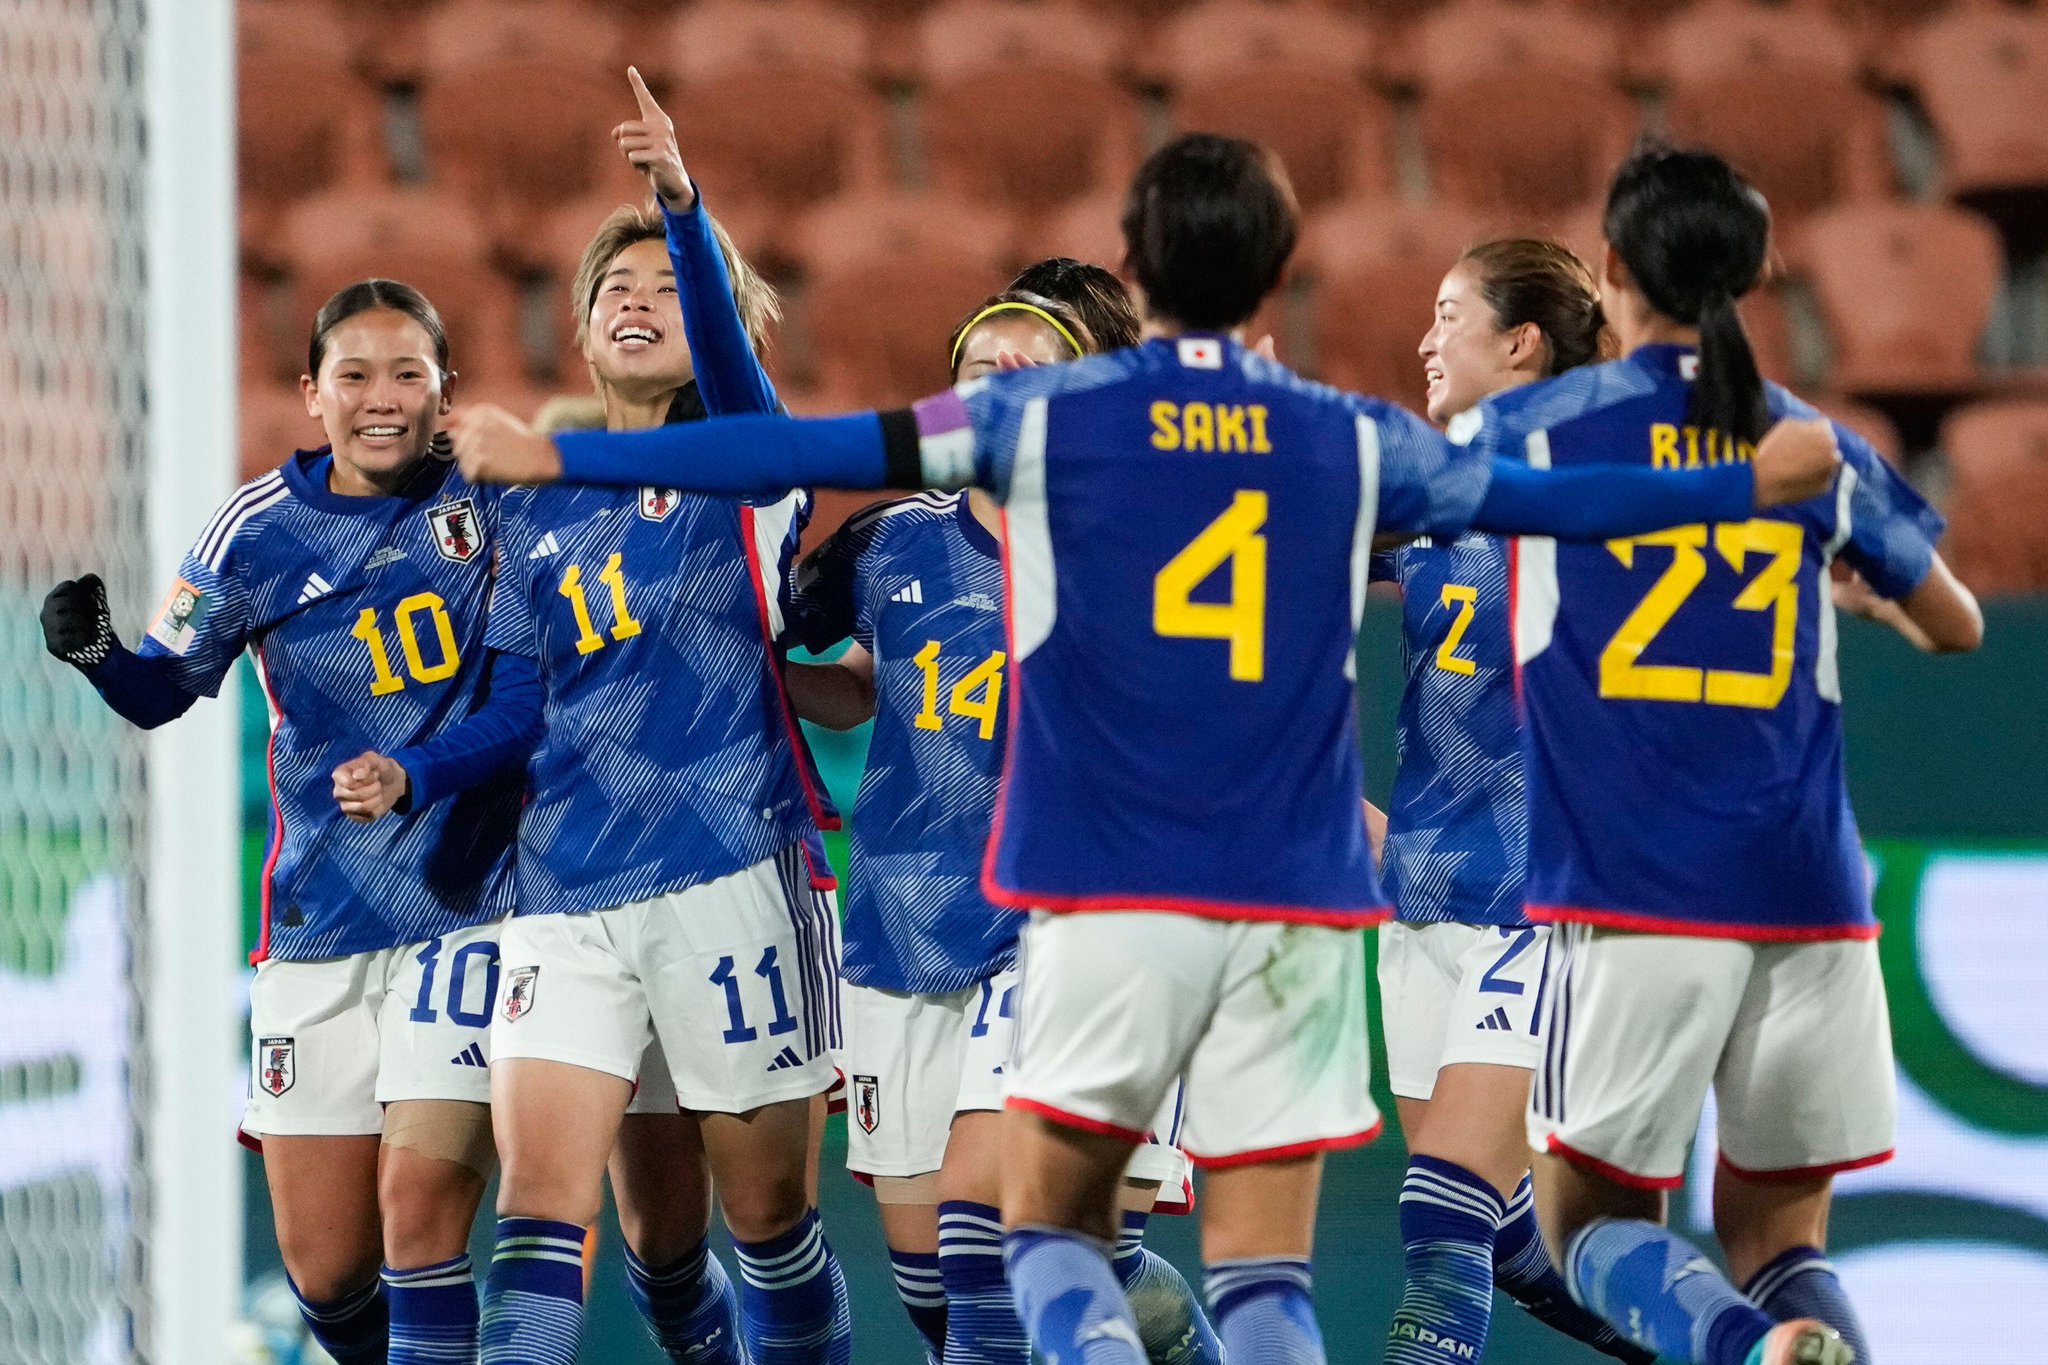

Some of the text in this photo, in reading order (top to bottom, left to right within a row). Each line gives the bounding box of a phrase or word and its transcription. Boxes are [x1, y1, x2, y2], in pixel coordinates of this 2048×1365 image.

[1150, 401, 1270, 454] SAKI
[437, 502, 462, 515] JAPAN
[559, 553, 642, 656] 11
[1153, 490, 1269, 683] 4
[1436, 584, 1478, 677] 2
[1599, 518, 1805, 709] 23
[352, 592, 461, 697] 10
[913, 641, 1007, 740] 14
[410, 938, 500, 1029] 10
[708, 945, 798, 1044] 11
[970, 976, 1019, 1038] 1
[1478, 927, 1537, 996] 2
[1388, 1321, 1475, 1360] JAPAN
